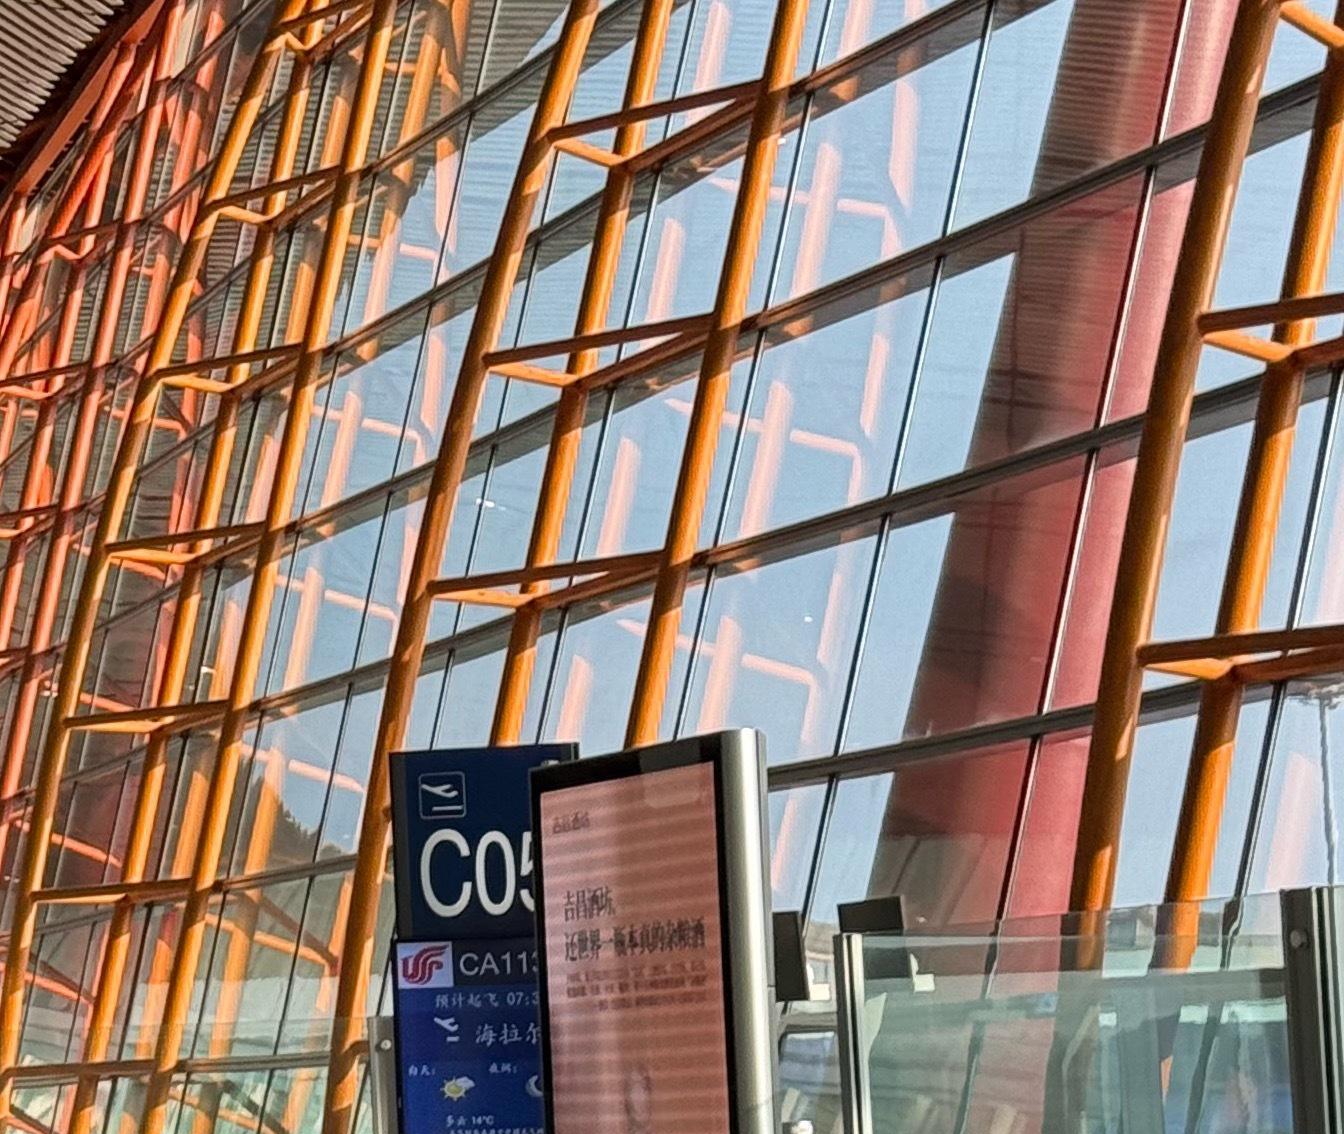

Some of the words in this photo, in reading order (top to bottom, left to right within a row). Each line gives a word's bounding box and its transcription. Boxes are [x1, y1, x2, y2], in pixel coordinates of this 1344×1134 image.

[435, 992, 499, 1008] 预计起飞
[506, 991, 539, 1005] 07:3
